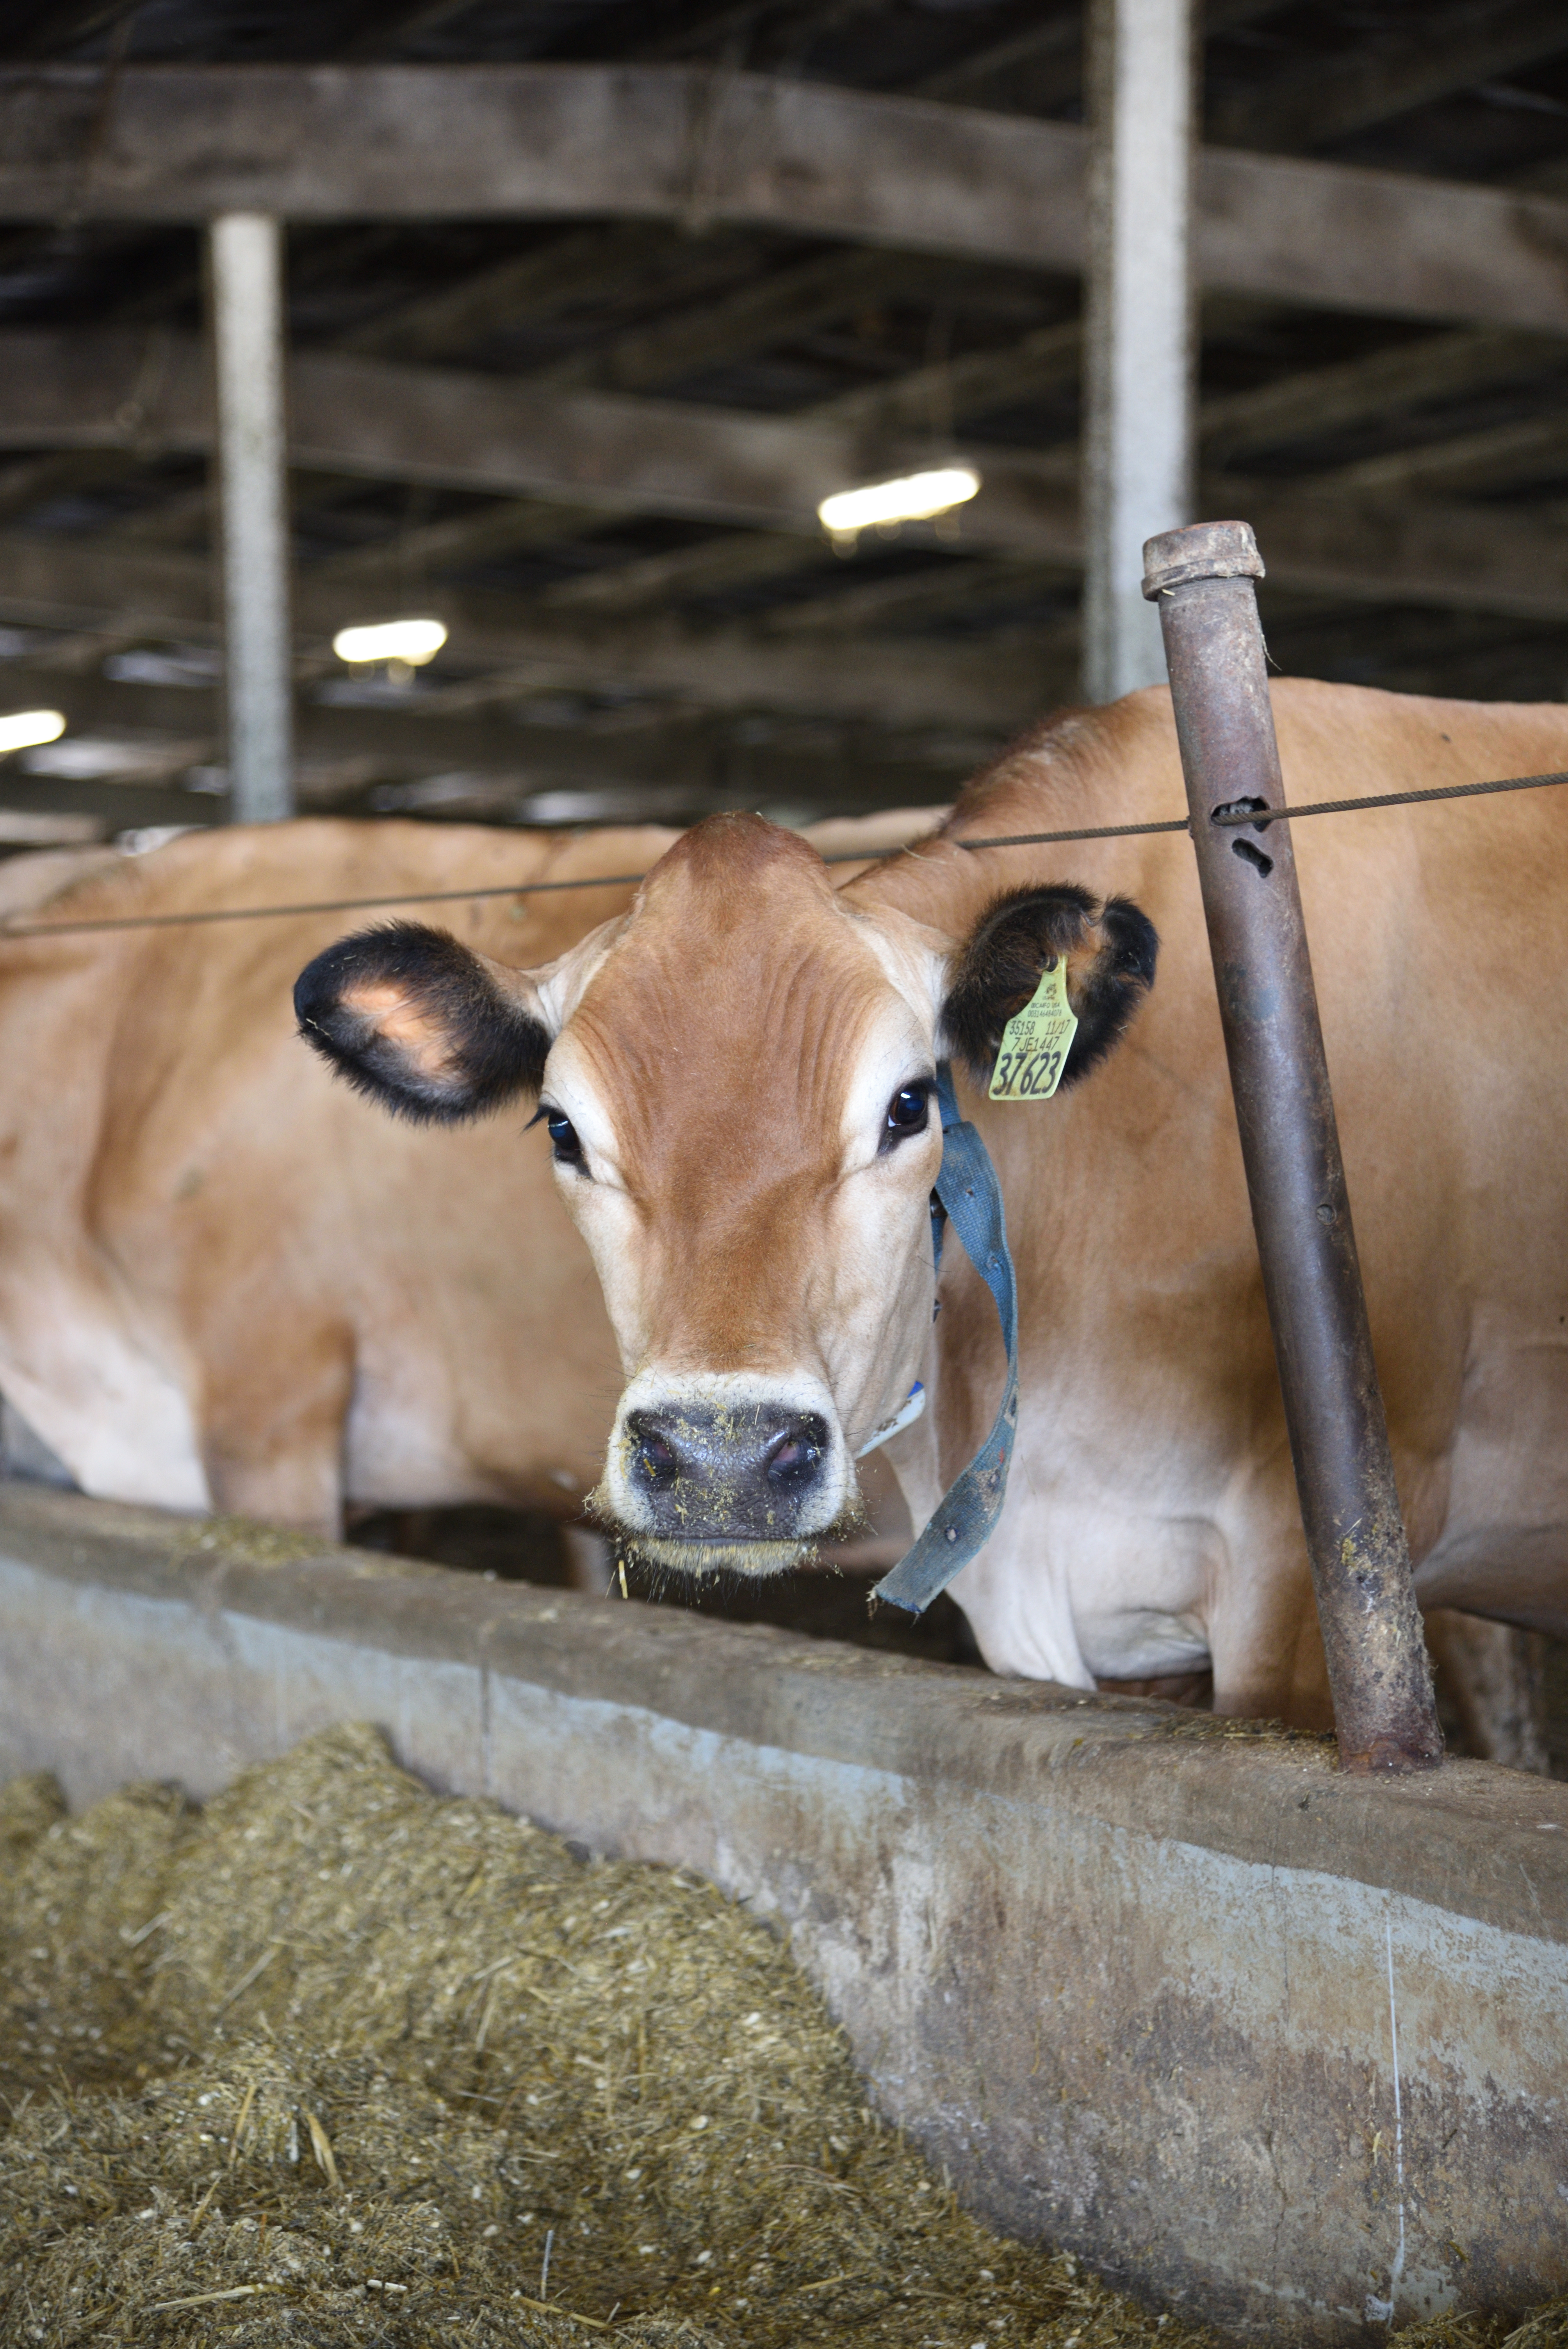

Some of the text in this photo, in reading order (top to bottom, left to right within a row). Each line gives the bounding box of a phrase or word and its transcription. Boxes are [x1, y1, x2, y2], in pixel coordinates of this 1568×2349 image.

[1009, 1019, 1071, 1035] 35158 11/17
[992, 1051, 1061, 1095] 37623
